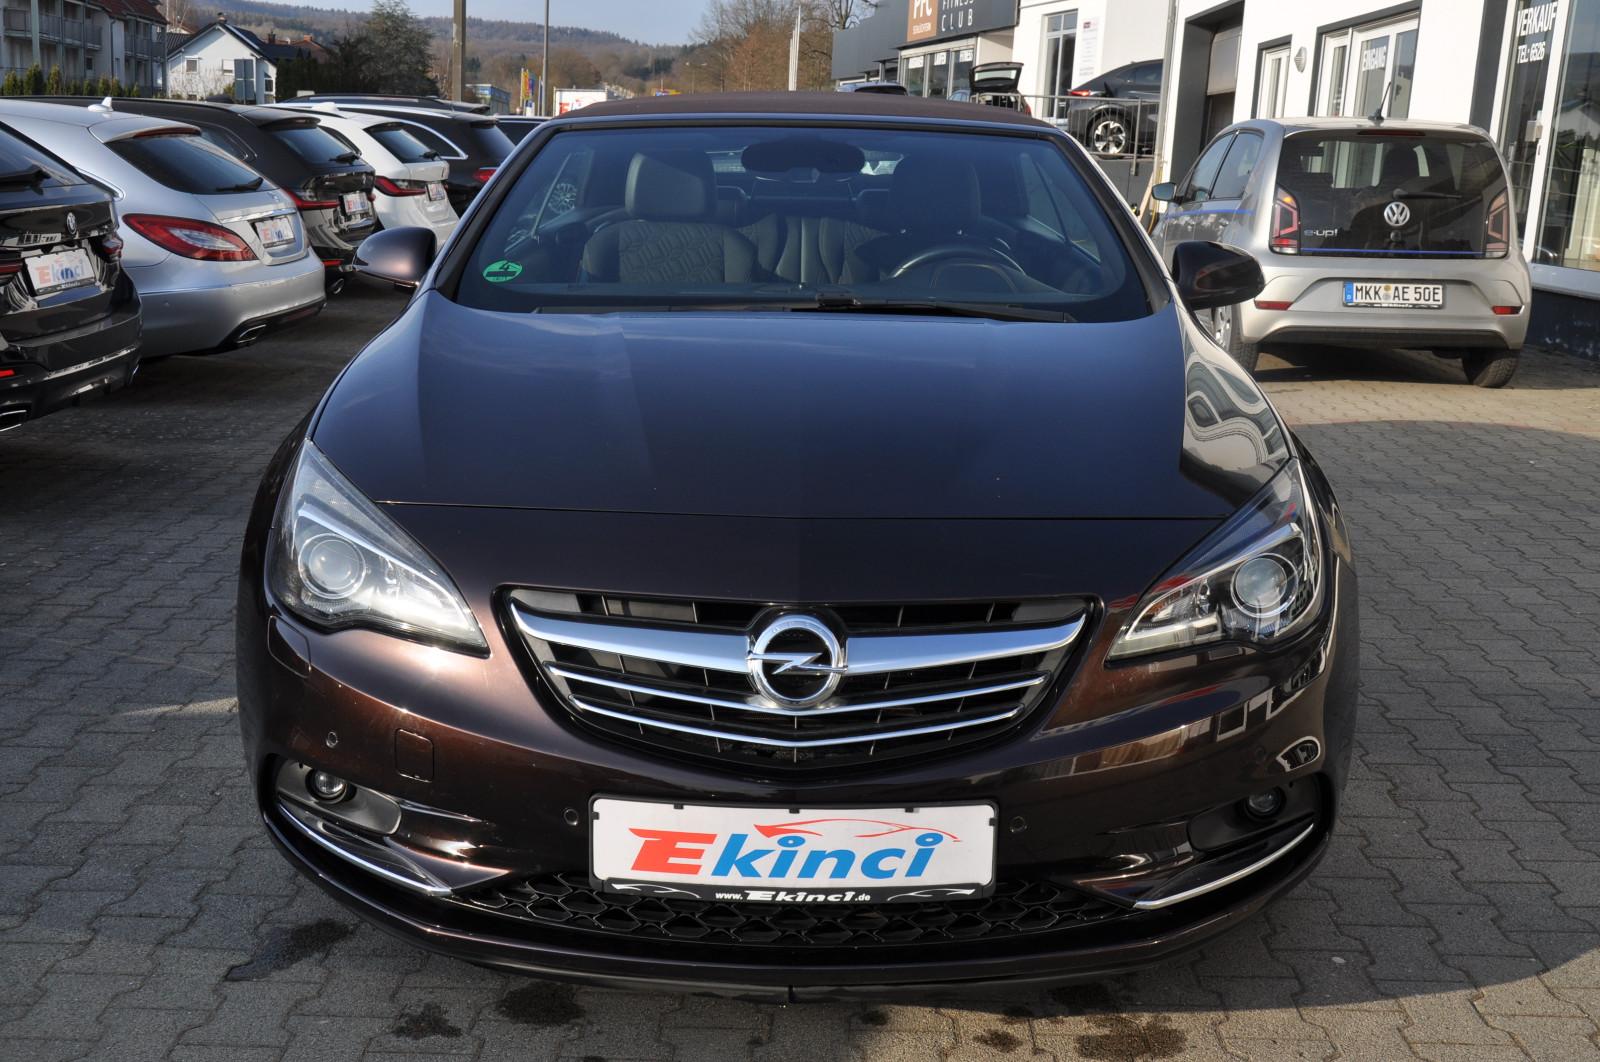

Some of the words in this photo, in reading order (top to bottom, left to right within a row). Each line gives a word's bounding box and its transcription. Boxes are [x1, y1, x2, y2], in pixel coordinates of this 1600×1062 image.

[942, 8, 973, 32] CLUB
[1516, 1, 1558, 37] VERKAUF
[1304, 228, 1338, 238] e-up!
[1355, 285, 1382, 300] MKK
[1393, 286, 1410, 301] AE
[1414, 287, 1440, 302] 50E
[628, 828, 944, 880] Ekinci
[715, 889, 871, 903] www.Ekinci.de
